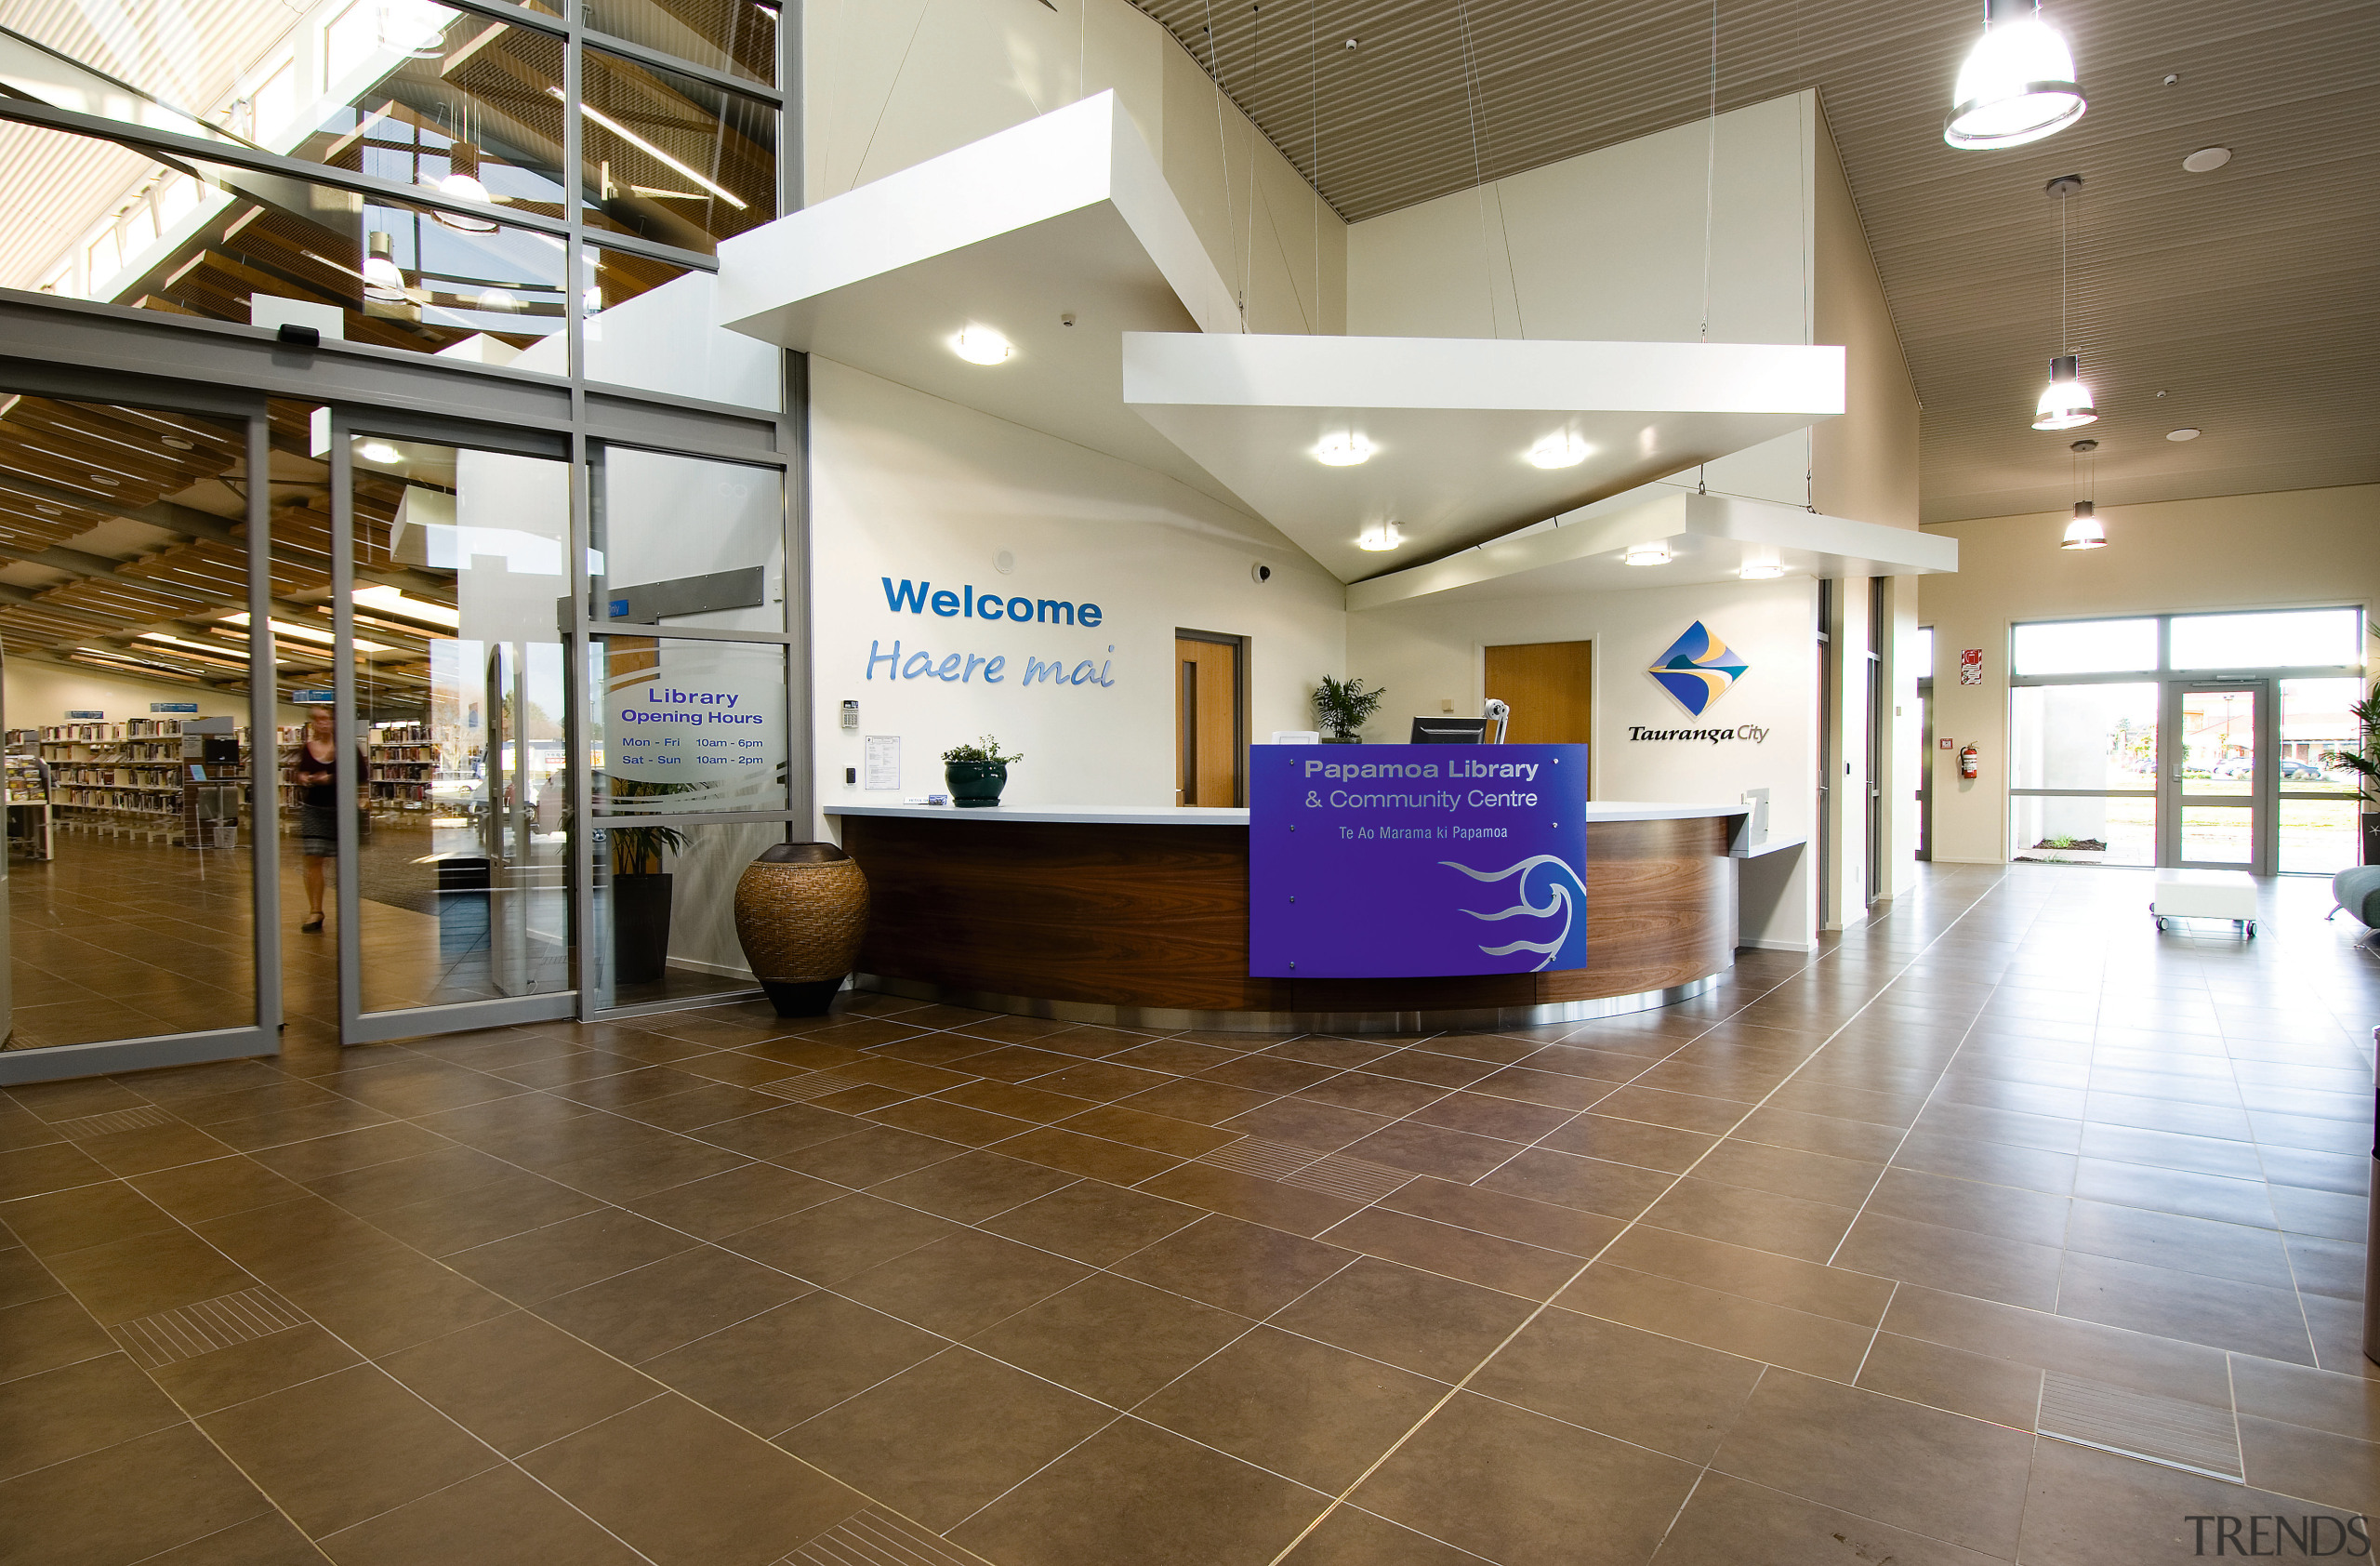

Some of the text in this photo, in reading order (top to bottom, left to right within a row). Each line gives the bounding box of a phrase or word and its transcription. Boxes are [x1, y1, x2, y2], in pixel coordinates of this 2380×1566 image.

[881, 577, 1103, 628] Welcome
[866, 640, 1116, 687] Haere mai
[649, 688, 739, 708] Library
[621, 710, 763, 725] Opening Hours
[622, 738, 651, 747] Mon
[738, 739, 763, 749] 6pm
[1629, 724, 1769, 744] Tauranga City
[623, 755, 643, 764] Sat
[657, 756, 681, 764] Sun
[696, 756, 727, 764] 10am
[738, 756, 763, 766] 2pm
[1305, 760, 1539, 782] Papamoa Library
[1305, 790, 1538, 812] & Community Centre
[1340, 827, 1507, 841] Te Ao Marama ki Papamoa
